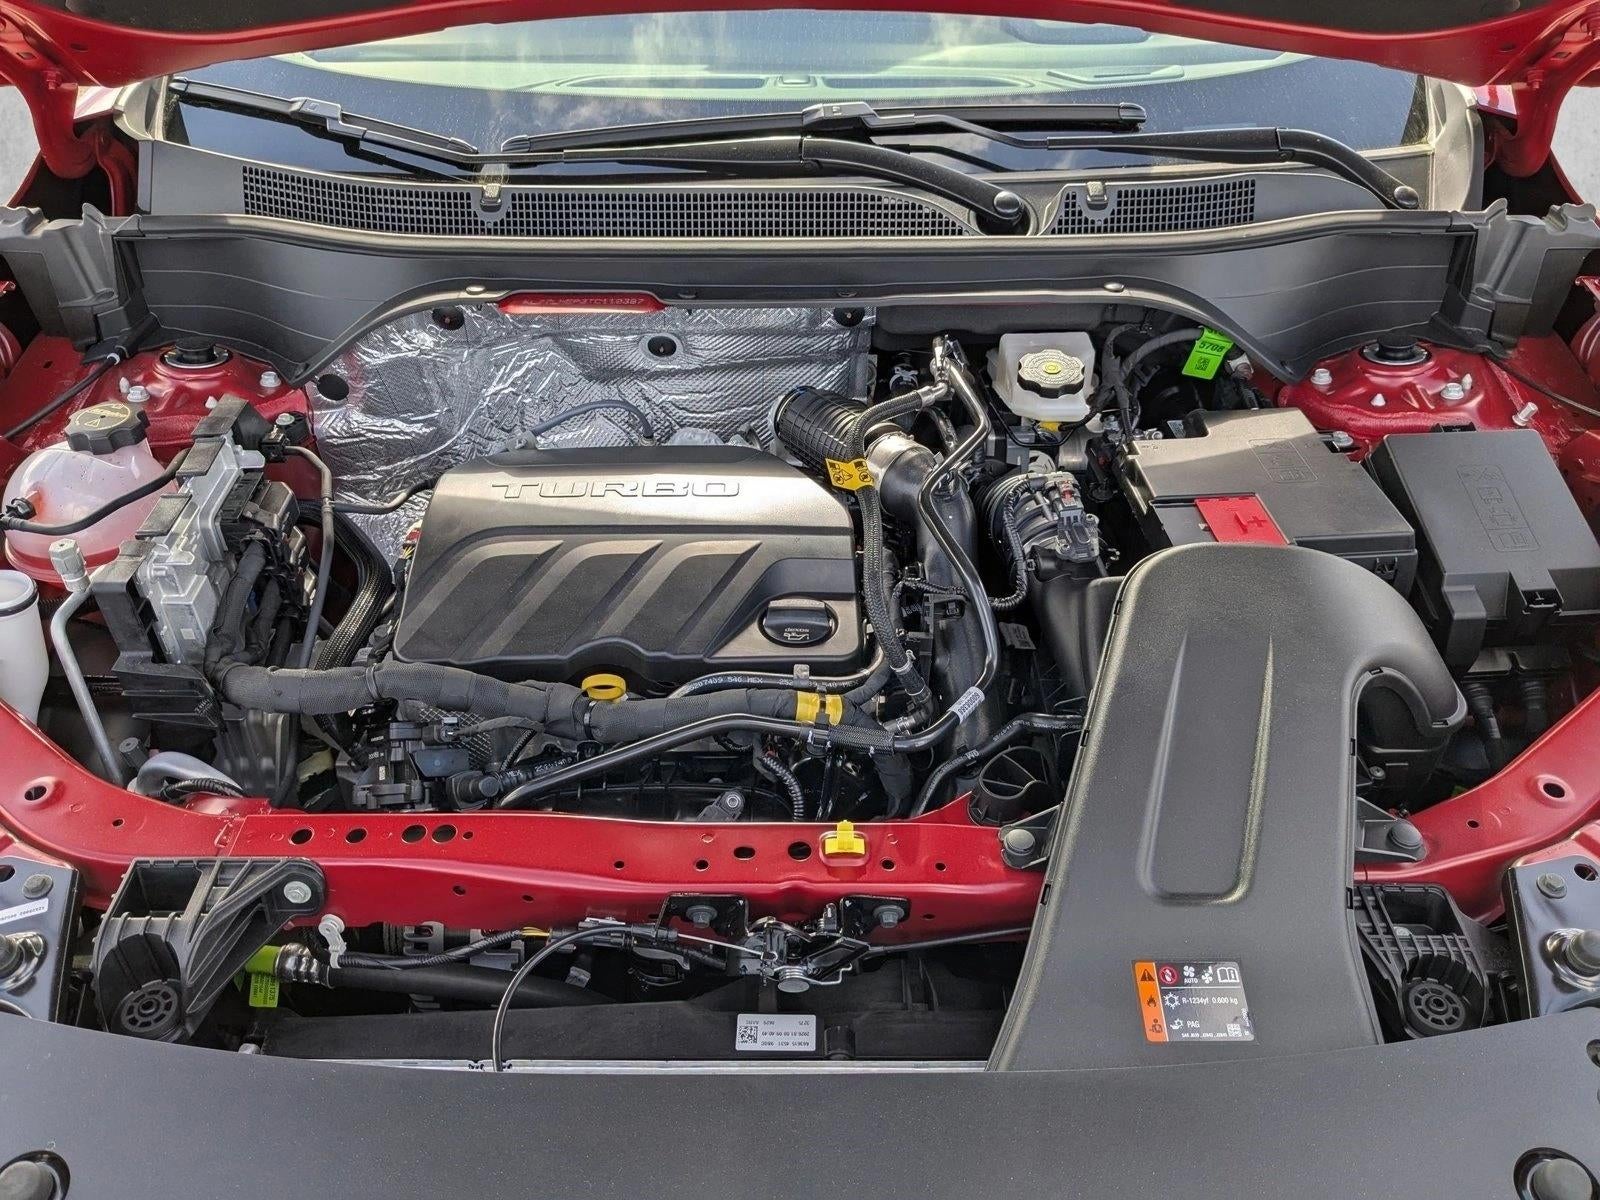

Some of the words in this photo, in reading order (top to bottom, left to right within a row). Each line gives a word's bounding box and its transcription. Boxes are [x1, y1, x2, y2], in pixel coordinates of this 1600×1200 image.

[491, 481, 741, 499] TURBO
[1230, 997, 1239, 1005] kg
[1186, 1020, 1200, 1028] PAG
